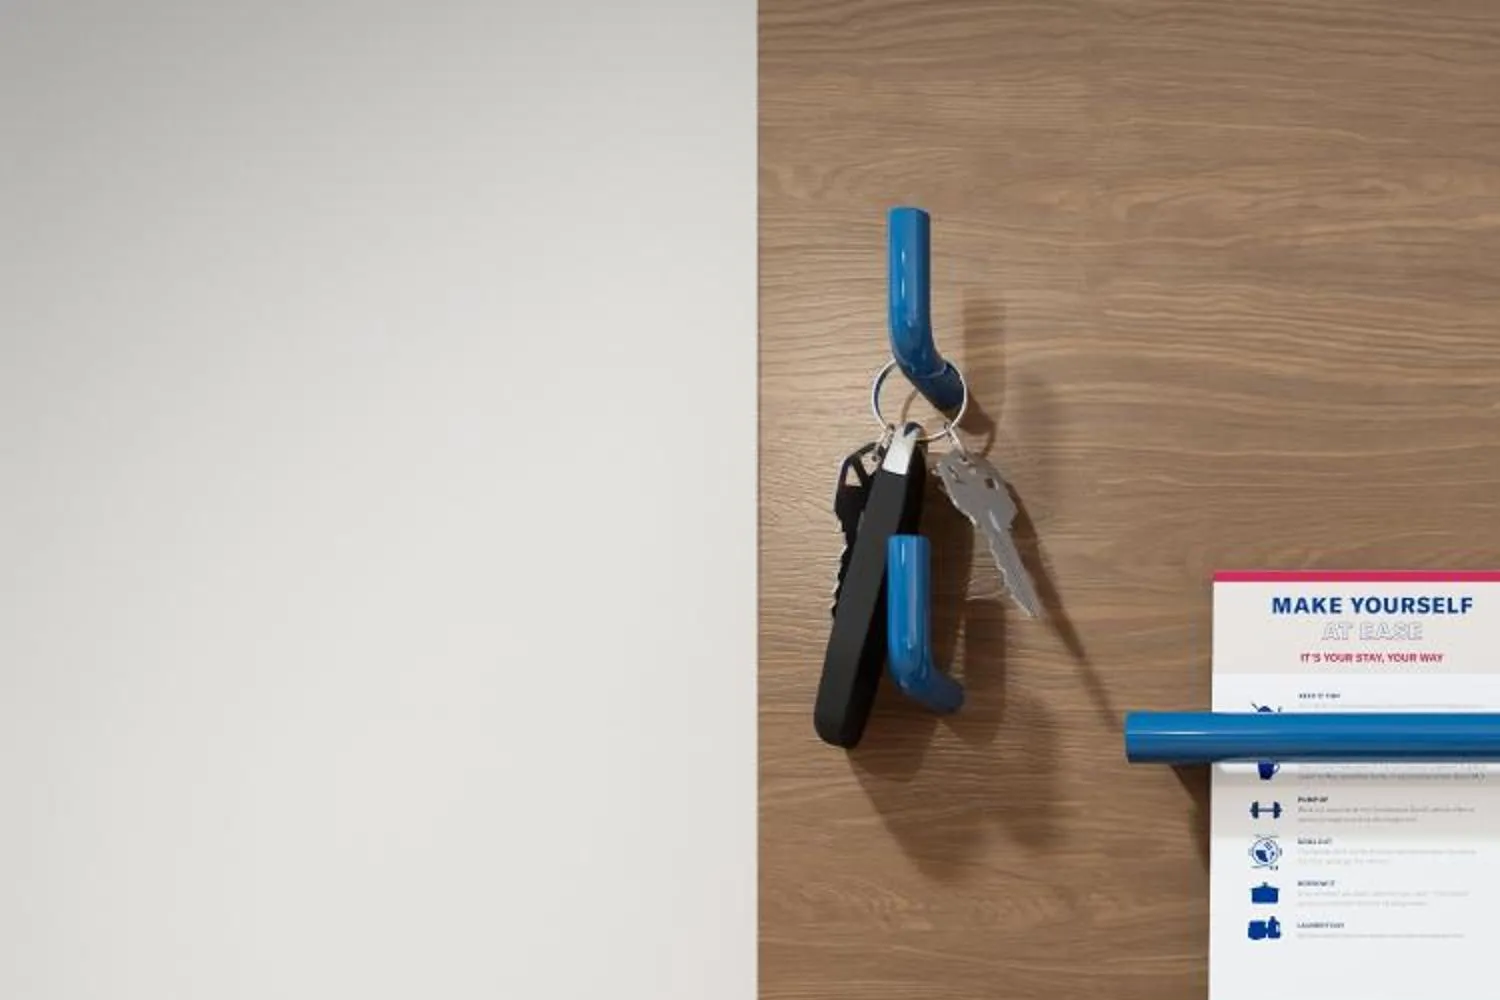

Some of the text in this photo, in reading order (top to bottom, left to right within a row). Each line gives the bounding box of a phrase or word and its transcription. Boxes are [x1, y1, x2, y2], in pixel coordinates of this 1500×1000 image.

[1272, 597, 1473, 614] MAKE YOURSELF
[1321, 621, 1423, 641] AT EASE
[1300, 653, 1444, 664] IT'S YOUR STAY, YOUR WAY
